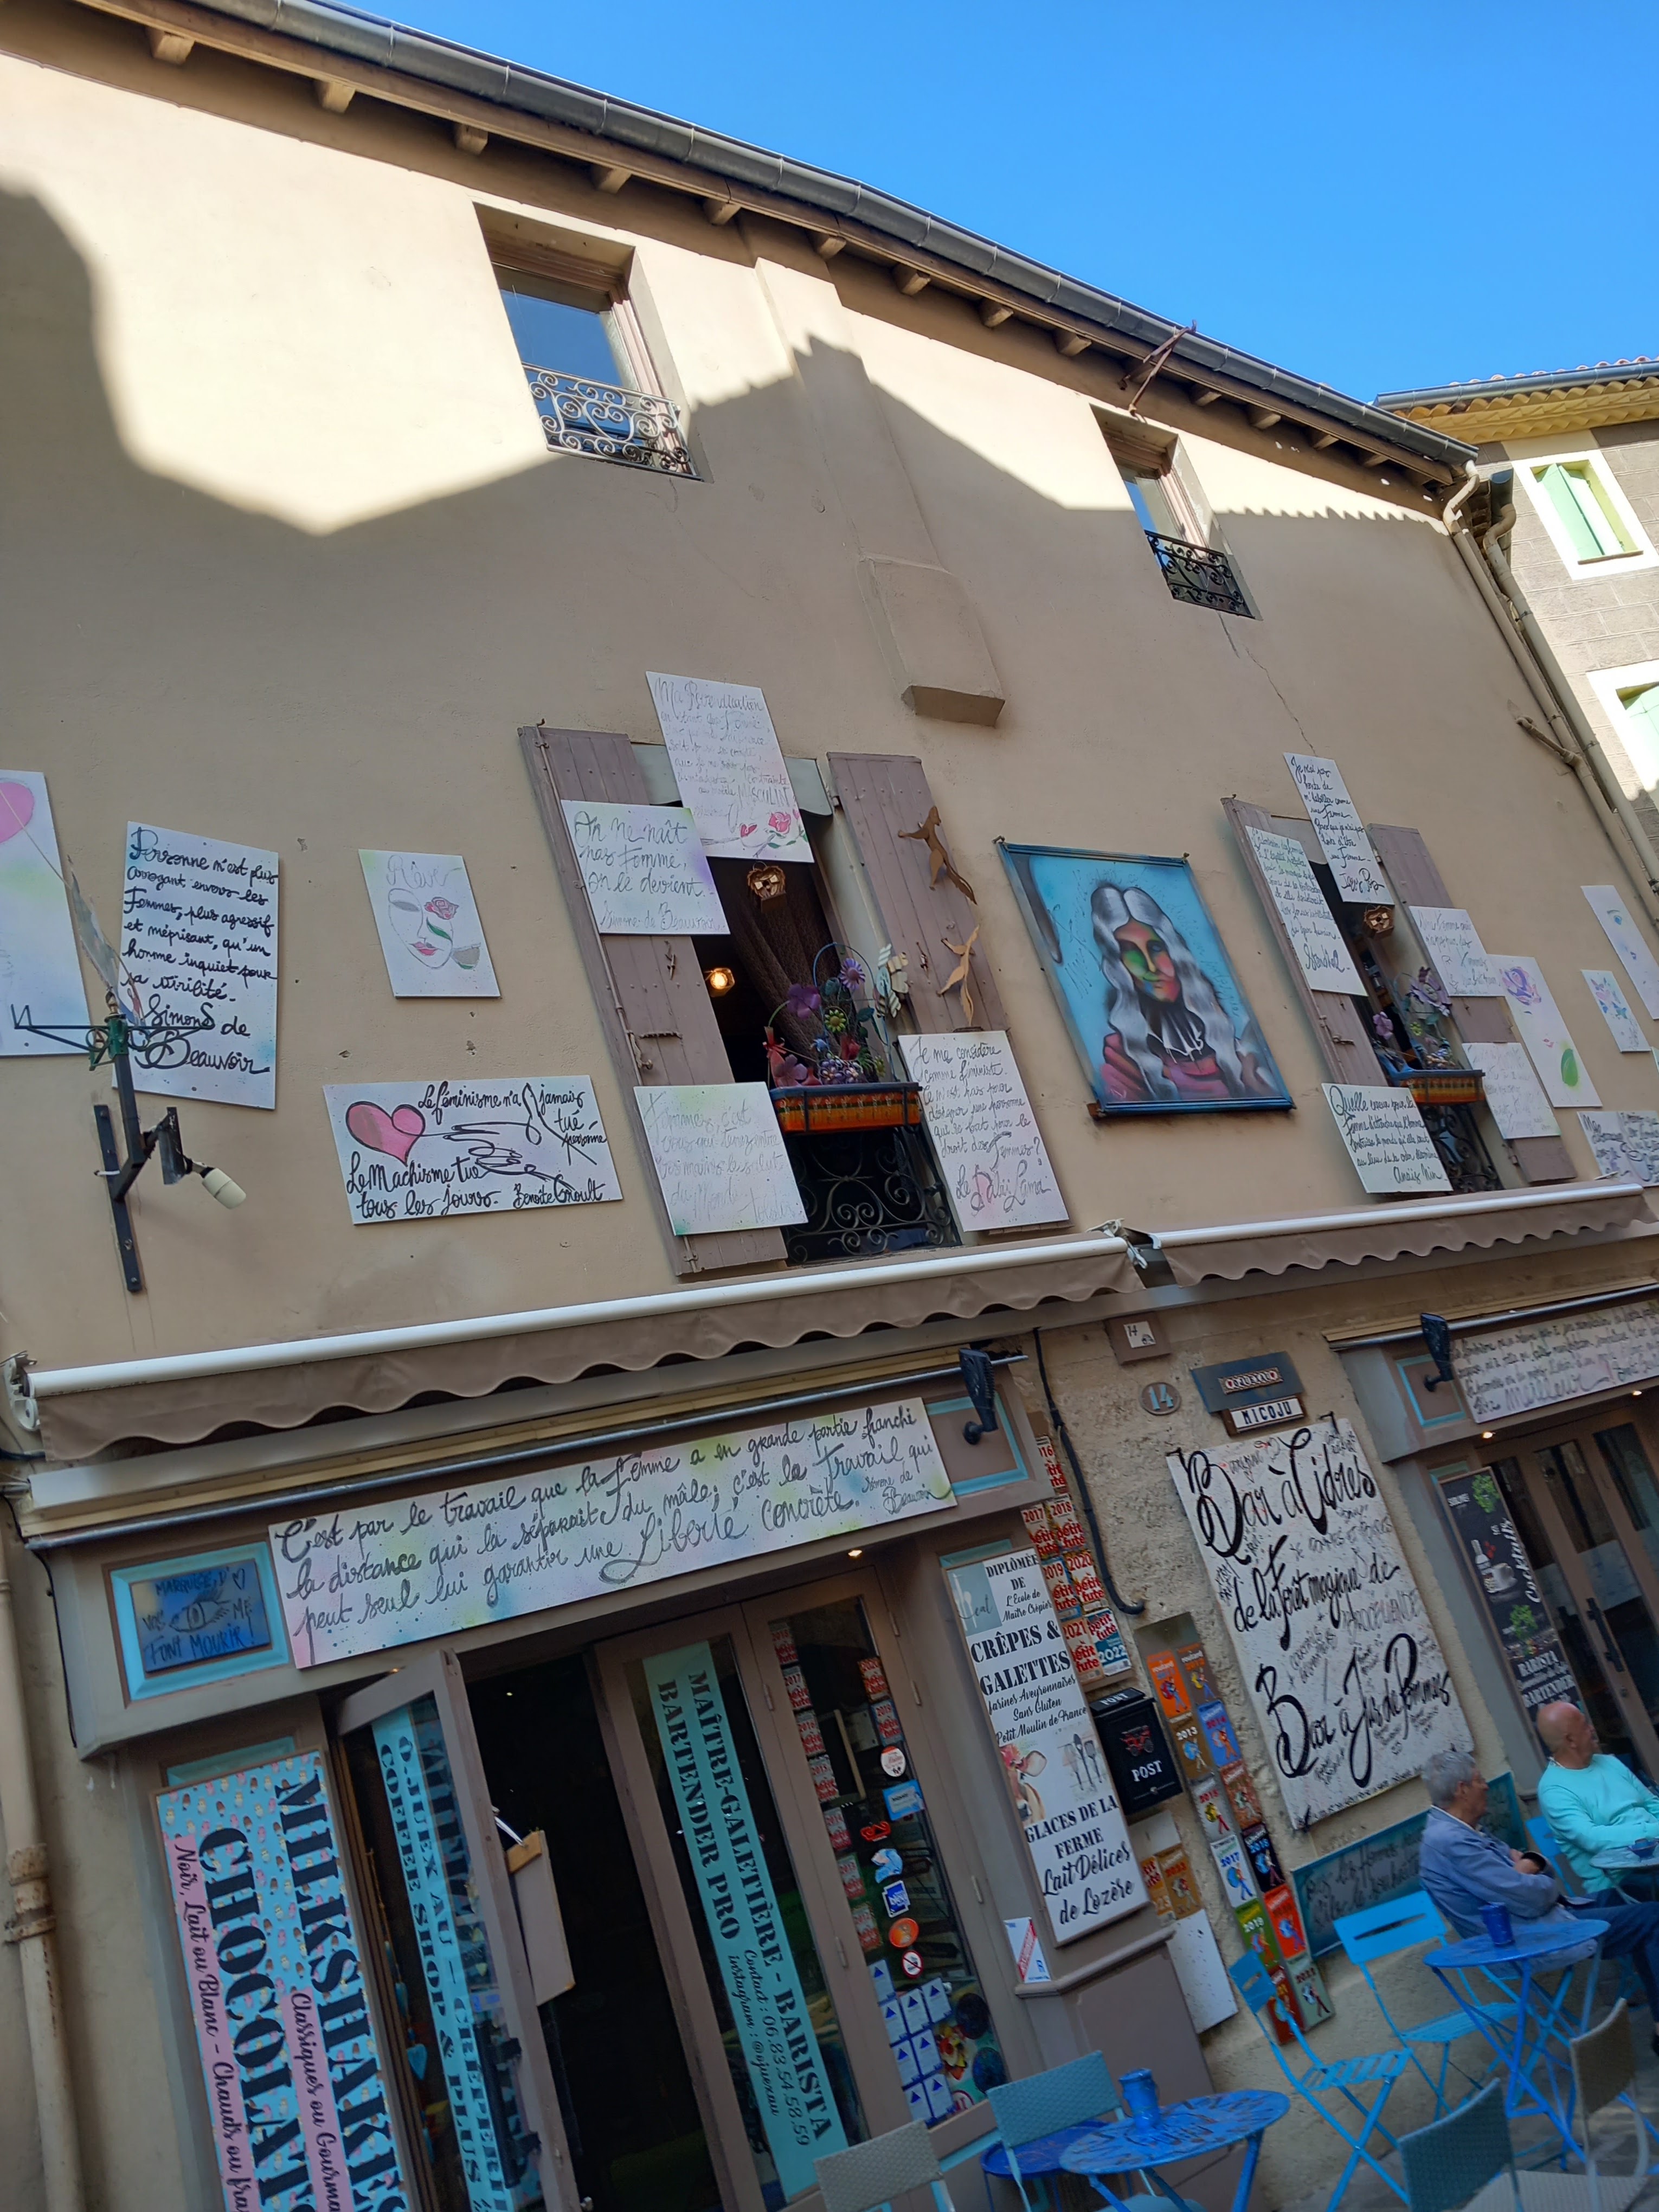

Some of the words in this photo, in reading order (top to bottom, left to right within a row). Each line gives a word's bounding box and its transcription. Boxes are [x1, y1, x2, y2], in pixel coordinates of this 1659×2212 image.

[574, 811, 606, 848] On
[610, 817, 645, 843] ne
[644, 820, 688, 844] naît
[130, 826, 210, 870] Personne
[213, 857, 248, 877] n'est
[249, 868, 278, 888] plus
[192, 877, 239, 898] envers
[239, 889, 268, 905] les
[613, 872, 633, 892] le
[124, 886, 183, 921] Femmes,
[185, 905, 219, 925] plus
[221, 912, 274, 937] agressif
[124, 922, 143, 932] et
[148, 925, 218, 950] méprisant,
[222, 937, 271, 958] qu'un
[120, 973, 149, 986] sa
[122, 938, 177, 964] homme
[179, 951, 238, 976] inquiet
[237, 964, 278, 989] pour
[141, 993, 215, 1030] Simone
[221, 1016, 250, 1037] de
[134, 1030, 270, 1074] Beauvoir
[418, 1084, 435, 1109] Le
[434, 1081, 502, 1125] féminisme
[538, 1084, 586, 1116] jamais
[1329, 1085, 1368, 1117] Quelle
[346, 1150, 368, 1193] Le
[369, 1160, 455, 1193] Machisme
[554, 1174, 606, 1203] Groult
[1421, 1163, 1442, 1181] Nin
[356, 1192, 396, 1219] tous
[406, 1189, 441, 1217] les
[1127, 1324, 1138, 1336] 14
[1148, 1384, 1174, 1410] 14
[1242, 1401, 1292, 1424] NICOJU
[274, 1513, 343, 1564] C'est
[349, 1519, 394, 1559] par
[400, 1501, 433, 1534] le
[531, 1483, 567, 1520] que
[576, 1465, 602, 1500] la
[690, 1450, 705, 1466] a
[713, 1444, 741, 1462] en
[748, 1423, 805, 1463] grande
[810, 1415, 858, 1457] partie
[861, 1405, 917, 1445] franchi
[862, 1475, 895, 1494] Simone
[900, 1470, 913, 1484] de
[1269, 1465, 1302, 1517] à
[1278, 1412, 1375, 1535] Cidres
[287, 1557, 325, 1600] la
[329, 1553, 422, 1593] distance
[429, 1534, 467, 1574] qui
[477, 1524, 507, 1554] la
[511, 1502, 600, 1554] séparait
[623, 1491, 651, 1522] du
[733, 1468, 769, 1499] c'est
[909, 1435, 933, 1474] qui
[1022, 1507, 1045, 1523] 2017
[1050, 1501, 1072, 1516] 2018
[1165, 1446, 1282, 1565] Bar
[986, 1553, 1039, 1578] DIPLÔMÉE
[1068, 1553, 1092, 1572] 2020
[293, 1605, 352, 1664] peut
[358, 1580, 420, 1625] seul
[426, 1573, 467, 1605] lui
[484, 1544, 568, 1608] garantir
[575, 1540, 623, 1568] une
[599, 1509, 749, 1585] Liberté
[1011, 1577, 1026, 1591] DE
[1030, 1589, 1040, 1599] de
[1234, 1569, 1258, 1632] de
[1259, 1567, 1278, 1621] la
[1370, 1553, 1400, 1583] de
[1002, 1606, 1026, 1623] Maître
[1027, 1599, 1052, 1615] Crêpier
[1064, 1621, 1086, 1639] 2021
[970, 1624, 1043, 1663] CRÊPES
[1046, 1619, 1061, 1641] &
[1098, 1645, 1127, 1662] 2022
[980, 1650, 1071, 1696] GALETTES
[1019, 1674, 1076, 1705] Aveyronnaises
[1384, 1632, 1450, 1739] Pommes
[996, 1728, 1017, 1745] Petit
[1018, 1719, 1047, 1739] Moulin
[1049, 1714, 1059, 1725] de
[1059, 1706, 1088, 1724] France
[1013, 1706, 1033, 1722] Sans
[1035, 1697, 1062, 1714] Gluten
[1256, 1664, 1335, 1778] Bar
[1335, 1701, 1360, 1735] à
[1342, 1647, 1384, 1787] Jus
[1384, 1692, 1401, 1725] de
[1131, 1760, 1163, 1783] POST
[657, 1680, 720, 1868] BARTENDER
[706, 1871, 740, 1939] PRO
[1025, 1809, 1077, 1844] GLACES
[1079, 1804, 1099, 1821] DE
[1100, 1795, 1120, 1814] LA
[1054, 1827, 1104, 1860] FERME
[173, 1842, 198, 1901] Noir,
[1043, 1862, 1077, 1896] Lait
[1076, 1841, 1131, 1881] Délices
[184, 1901, 205, 1939] Lait
[1059, 1899, 1078, 1925] de
[1083, 1880, 1134, 1915] Lozère
[381, 1744, 420, 1892] COFFEE
[413, 1902, 446, 2016] SHOP
[448, 2075, 481, 2183] PLUS
[196, 1973, 221, 2037] Blanc
[199, 1828, 316, 2212] CHOCOLAT
[291, 1992, 321, 2096] Classiques
[774, 1988, 832, 2140] BARISTA
[210, 2059, 237, 2140] Chauds
